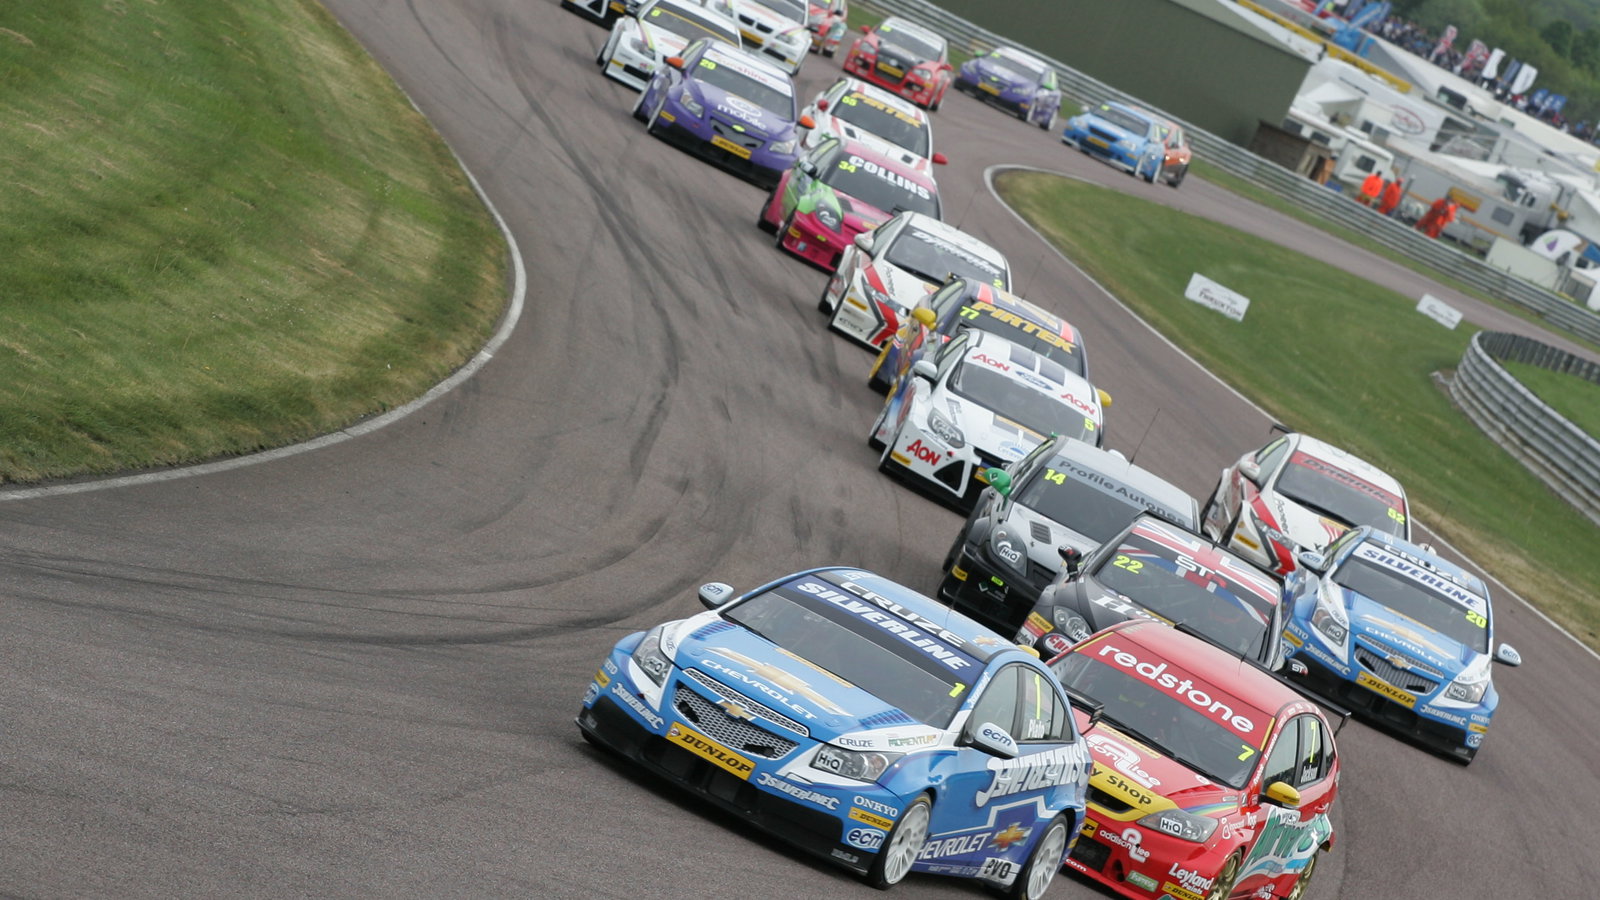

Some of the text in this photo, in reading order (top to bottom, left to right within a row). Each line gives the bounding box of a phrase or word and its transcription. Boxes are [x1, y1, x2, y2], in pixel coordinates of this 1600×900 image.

[717, 104, 767, 130] mobile
[850, 92, 922, 128] PIRTEK
[838, 160, 857, 173] 34
[849, 155, 930, 200] COLLINS
[959, 305, 981, 320] 77
[971, 300, 1078, 354] PIRTEK
[972, 353, 1010, 372] AON
[1061, 393, 1095, 415] AON
[1084, 417, 1095, 432] 5
[907, 439, 942, 467] AON
[1044, 468, 1067, 486] 14
[1058, 460, 1115, 490] Profile
[1387, 507, 1405, 525] 52
[1001, 547, 1018, 561] HiQ
[1112, 555, 1144, 575] 22
[840, 582, 967, 649] CRUZE
[1465, 610, 1488, 629] 20
[1366, 626, 1445, 667] CHEVROLET
[701, 658, 818, 721] CHEVROLET
[949, 682, 966, 698] 1
[1098, 644, 1254, 733] redstone
[1367, 677, 1416, 704] DUNLOP
[839, 737, 875, 748] CRUZE
[983, 728, 1012, 746] ecm
[681, 733, 752, 772] DUNLOP
[817, 752, 841, 769] HiQ
[1238, 745, 1255, 761] 7
[1106, 775, 1152, 805] Shop
[853, 795, 899, 817] ONKYO
[859, 813, 893, 828] DUNLOP
[1161, 821, 1181, 834] HiQ
[849, 828, 884, 849] ecm
[917, 832, 992, 860] HEVROLET
[1099, 829, 1132, 850] addison
[1168, 862, 1214, 891] Leyland
[1182, 882, 1204, 895] Paints
